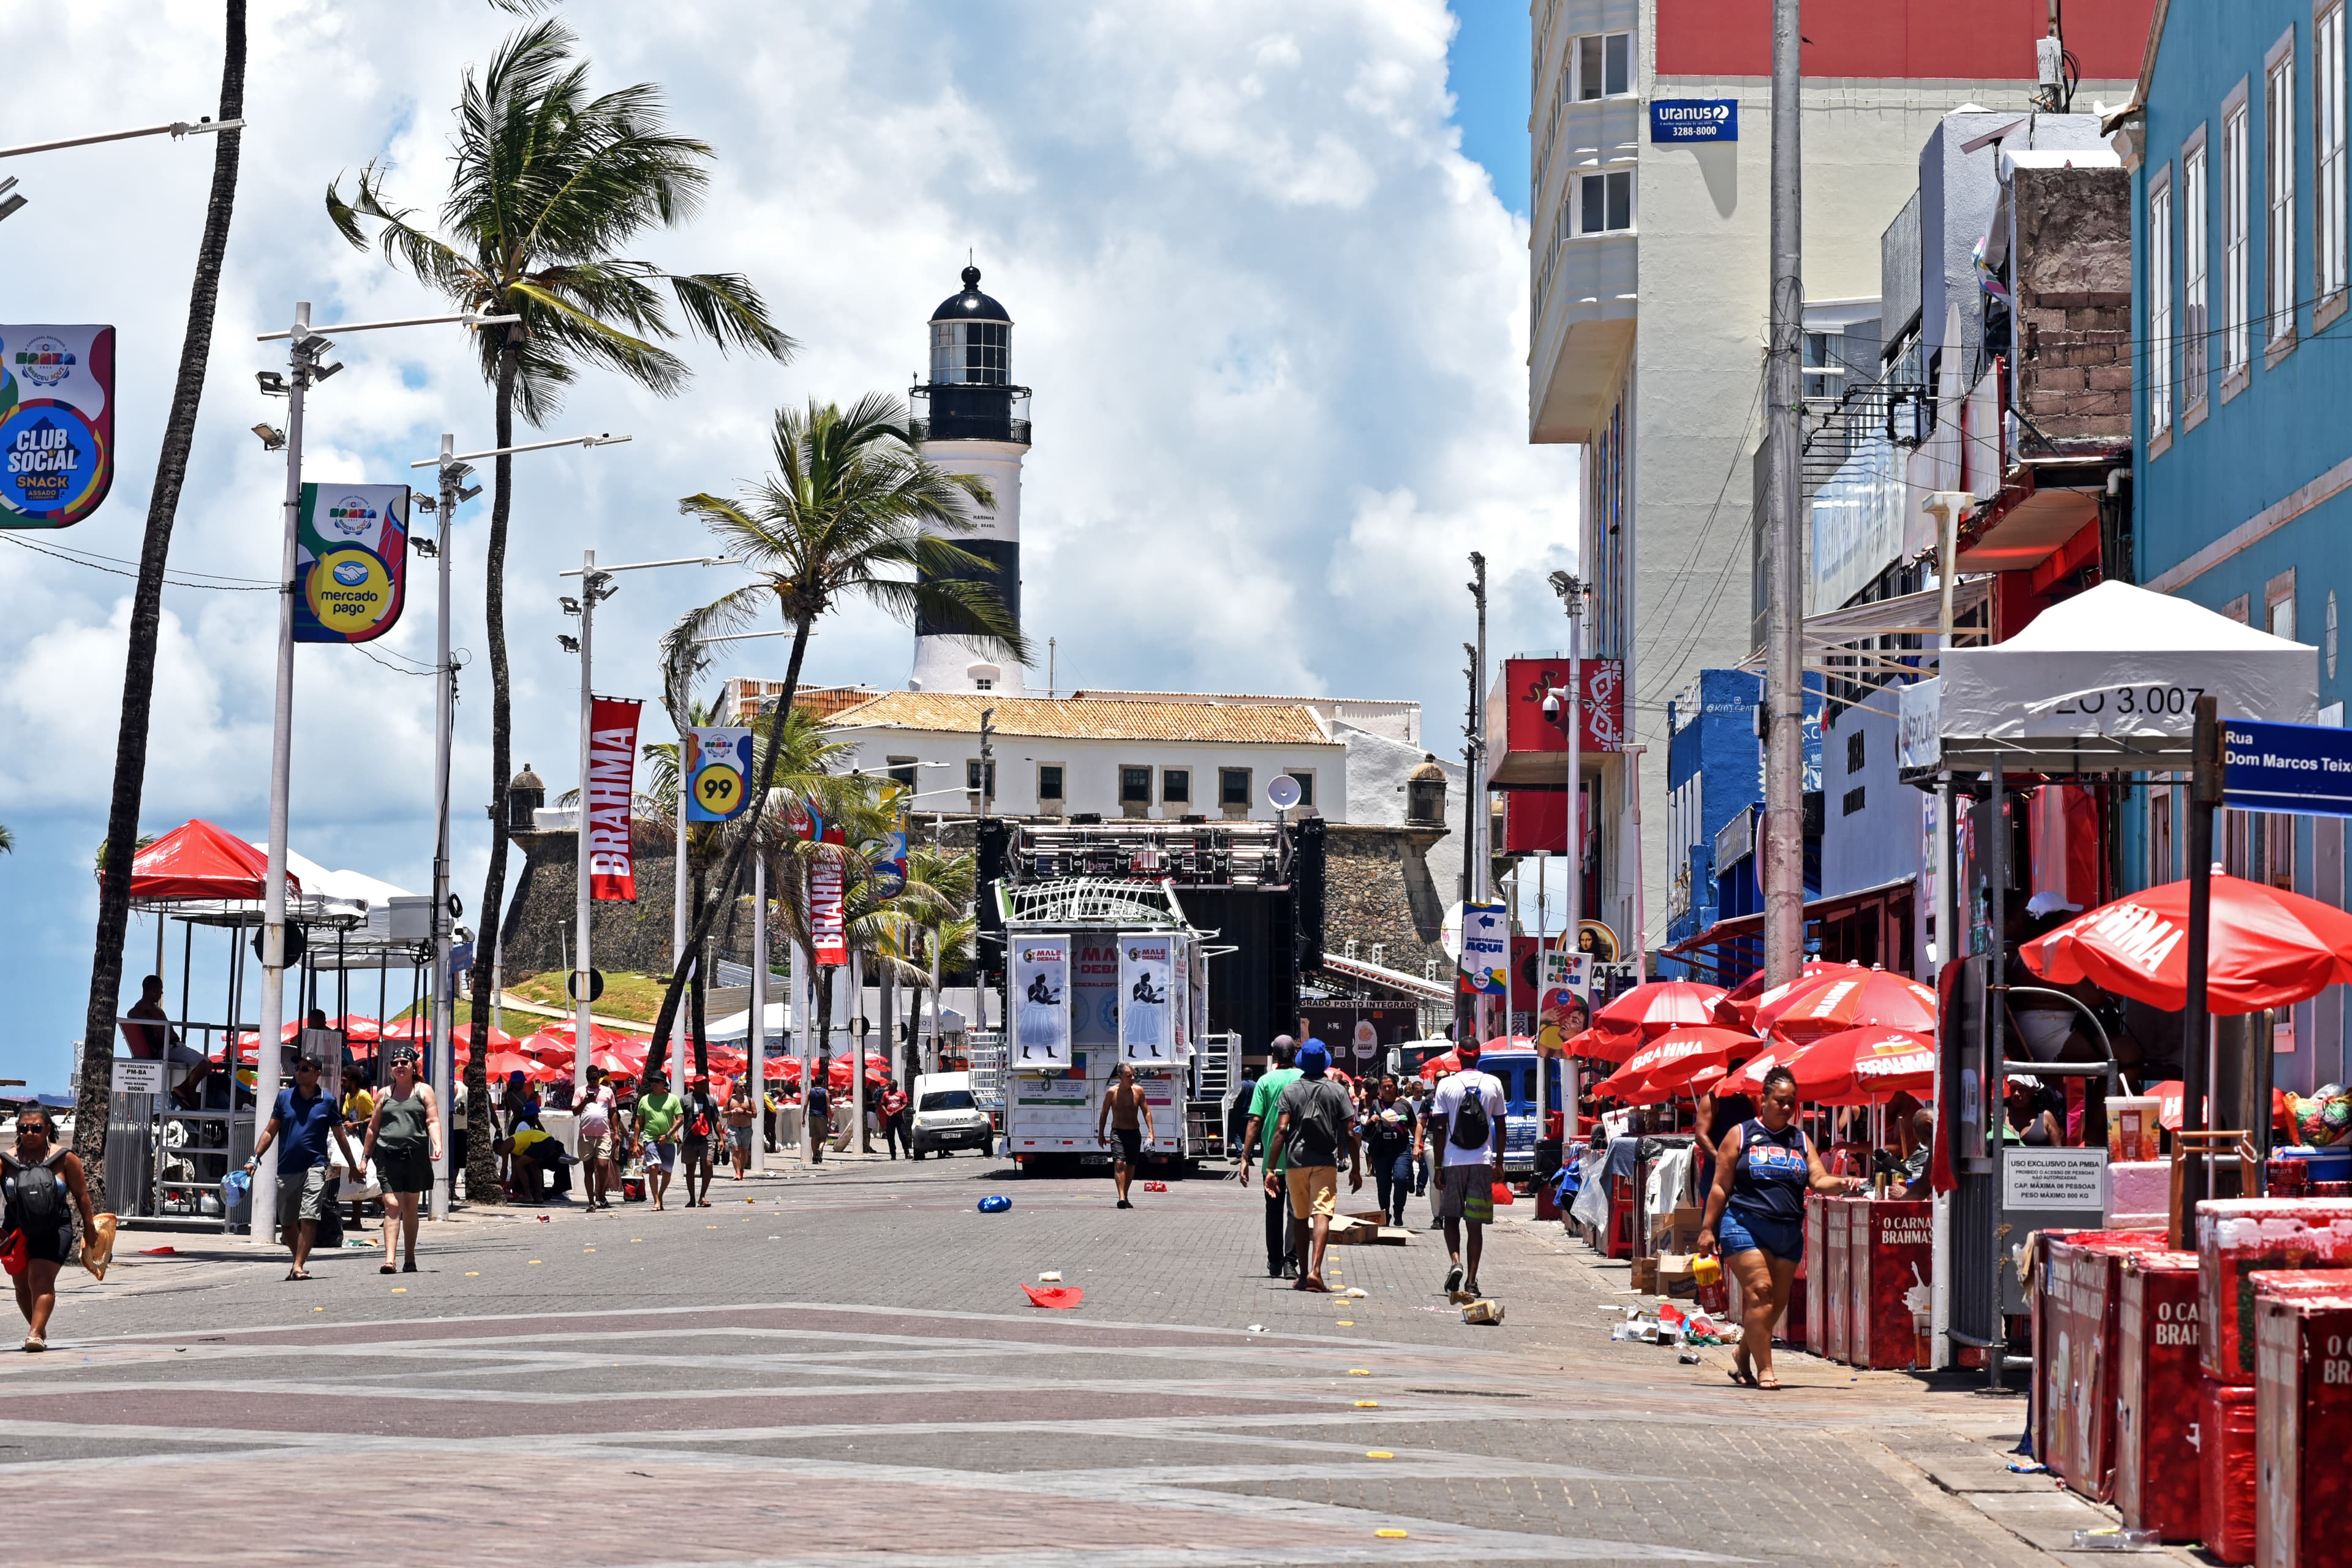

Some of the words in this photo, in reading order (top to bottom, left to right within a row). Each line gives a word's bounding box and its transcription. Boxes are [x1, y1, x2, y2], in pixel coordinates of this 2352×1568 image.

[1673, 126, 1717, 136] 3288-8000
[27, 366, 49, 381] NASCEU
[17, 428, 68, 451] CLUB
[17, 476, 68, 488] SNACK
[321, 590, 379, 601] mercado
[333, 603, 366, 616] pago
[2225, 731, 2253, 745] Rua
[2225, 750, 2260, 766] Dom
[2263, 753, 2318, 771] Marcos
[2321, 756, 2352, 773] Teix
[704, 779, 733, 799] 99
[590, 727, 634, 876] BRAHMA
[1464, 941, 1503, 953] AQUI
[1548, 954, 1583, 968] BECO
[1547, 973, 1581, 985] CORES
[1749, 1145, 1807, 1172] USA
[1883, 1217, 1891, 1229] O
[2158, 1302, 2171, 1321] O
[2176, 1302, 2200, 1321] CA
[2328, 1334, 2342, 1357] O
[2323, 1359, 2352, 1384] BR
